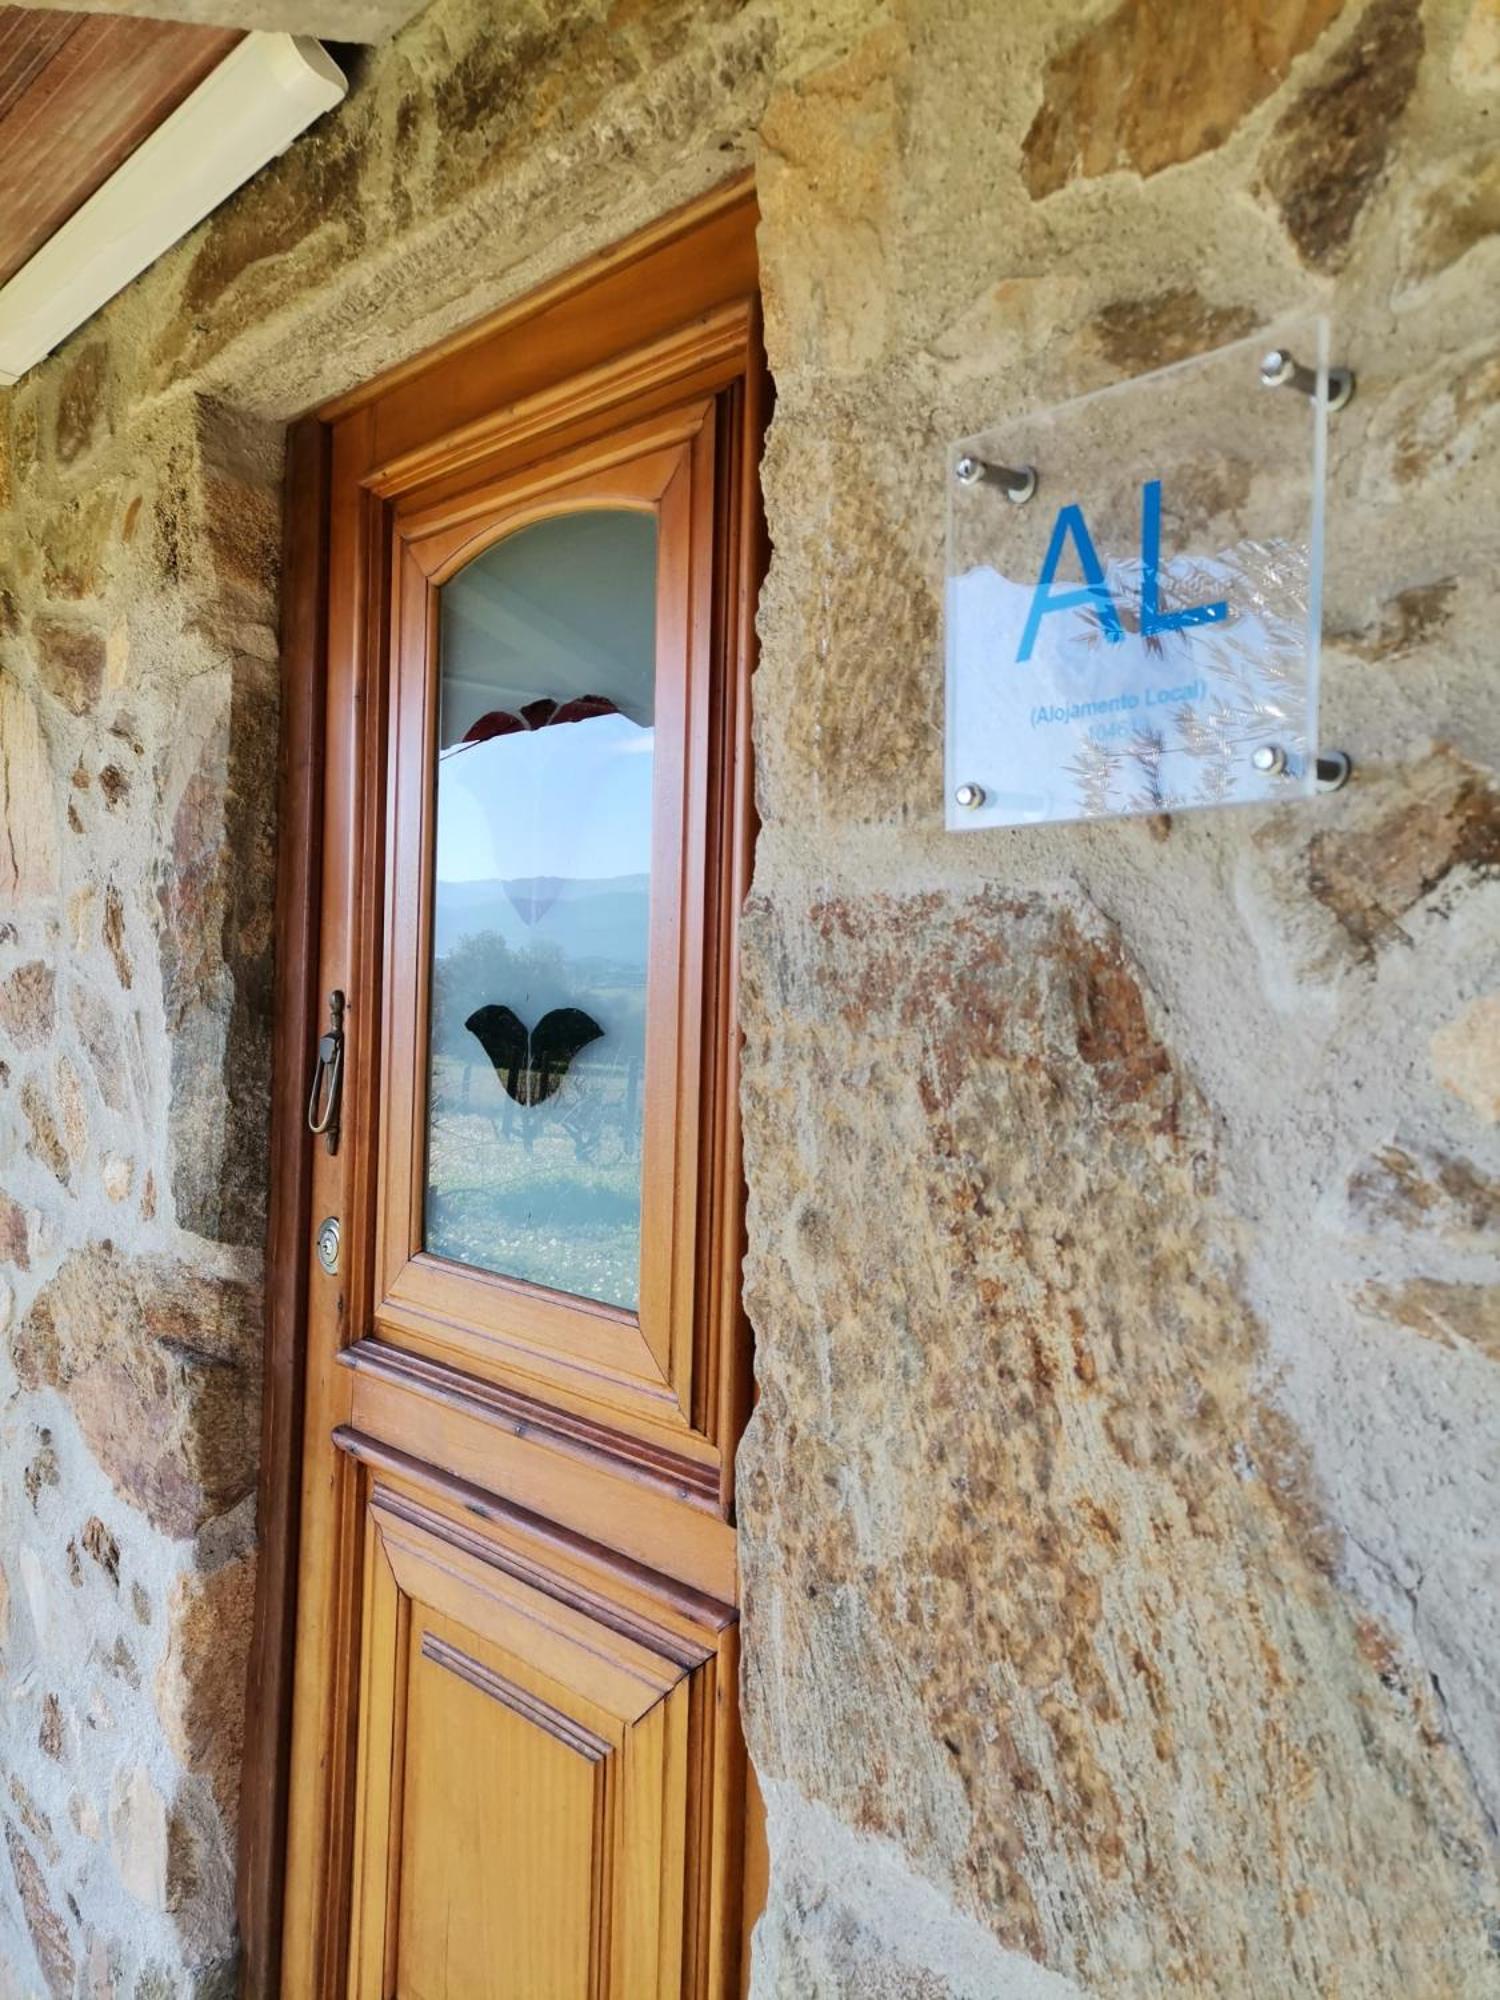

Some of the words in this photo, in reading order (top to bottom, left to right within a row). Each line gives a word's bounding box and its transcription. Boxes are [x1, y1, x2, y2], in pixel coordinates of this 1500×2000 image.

[1016, 479, 1228, 663] AL
[1031, 692, 1139, 729] (Alojamento
[1144, 678, 1208, 707] Local)
